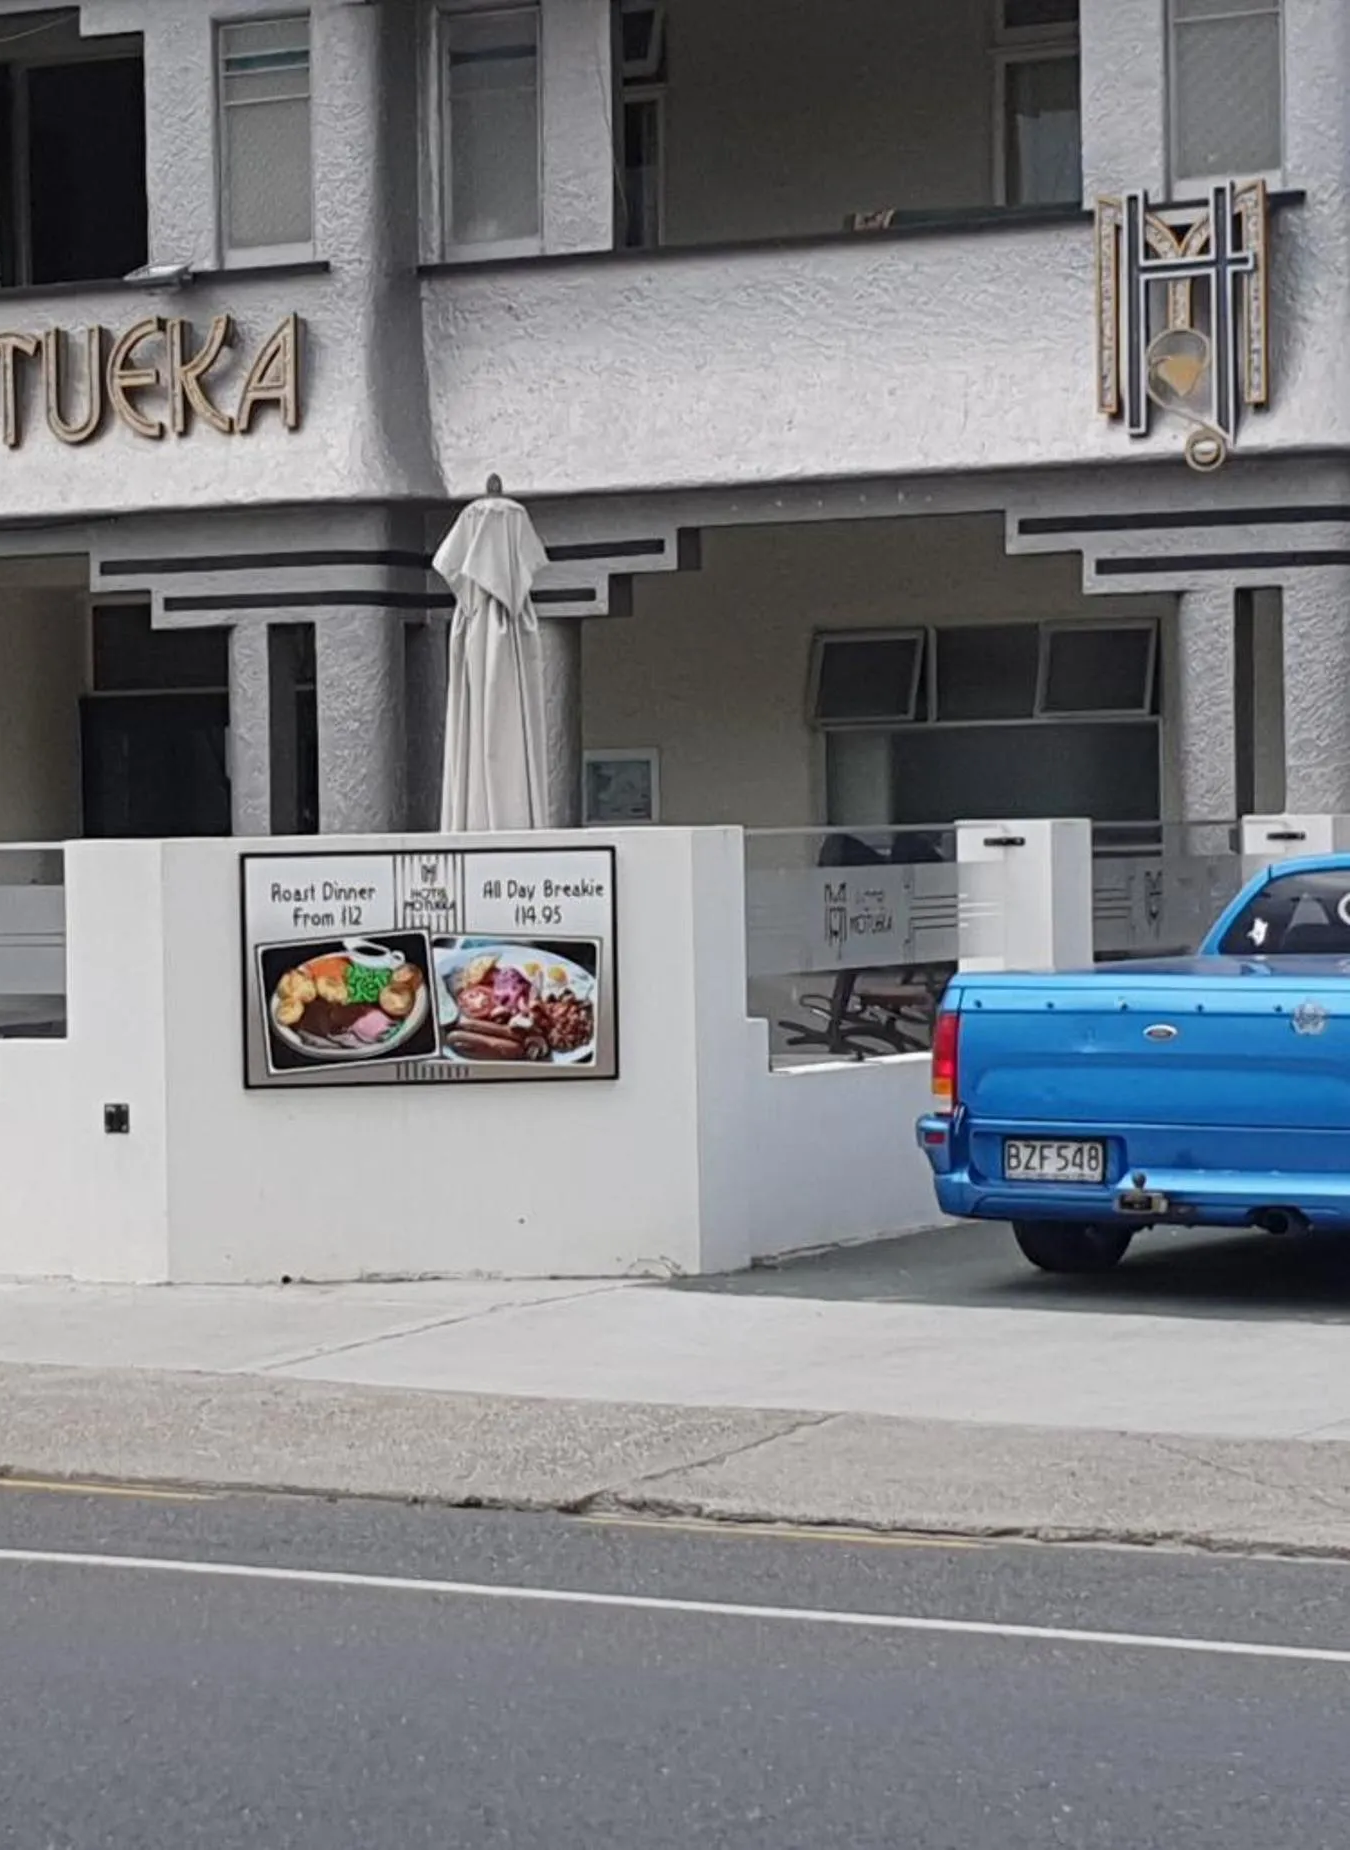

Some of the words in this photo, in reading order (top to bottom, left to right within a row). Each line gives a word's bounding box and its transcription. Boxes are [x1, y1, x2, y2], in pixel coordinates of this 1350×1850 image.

[270, 882, 316, 902] Roast
[321, 881, 377, 901] Dinner
[482, 880, 501, 899] All
[507, 879, 536, 902] Day
[543, 878, 605, 898] Breakie
[292, 906, 335, 928] From
